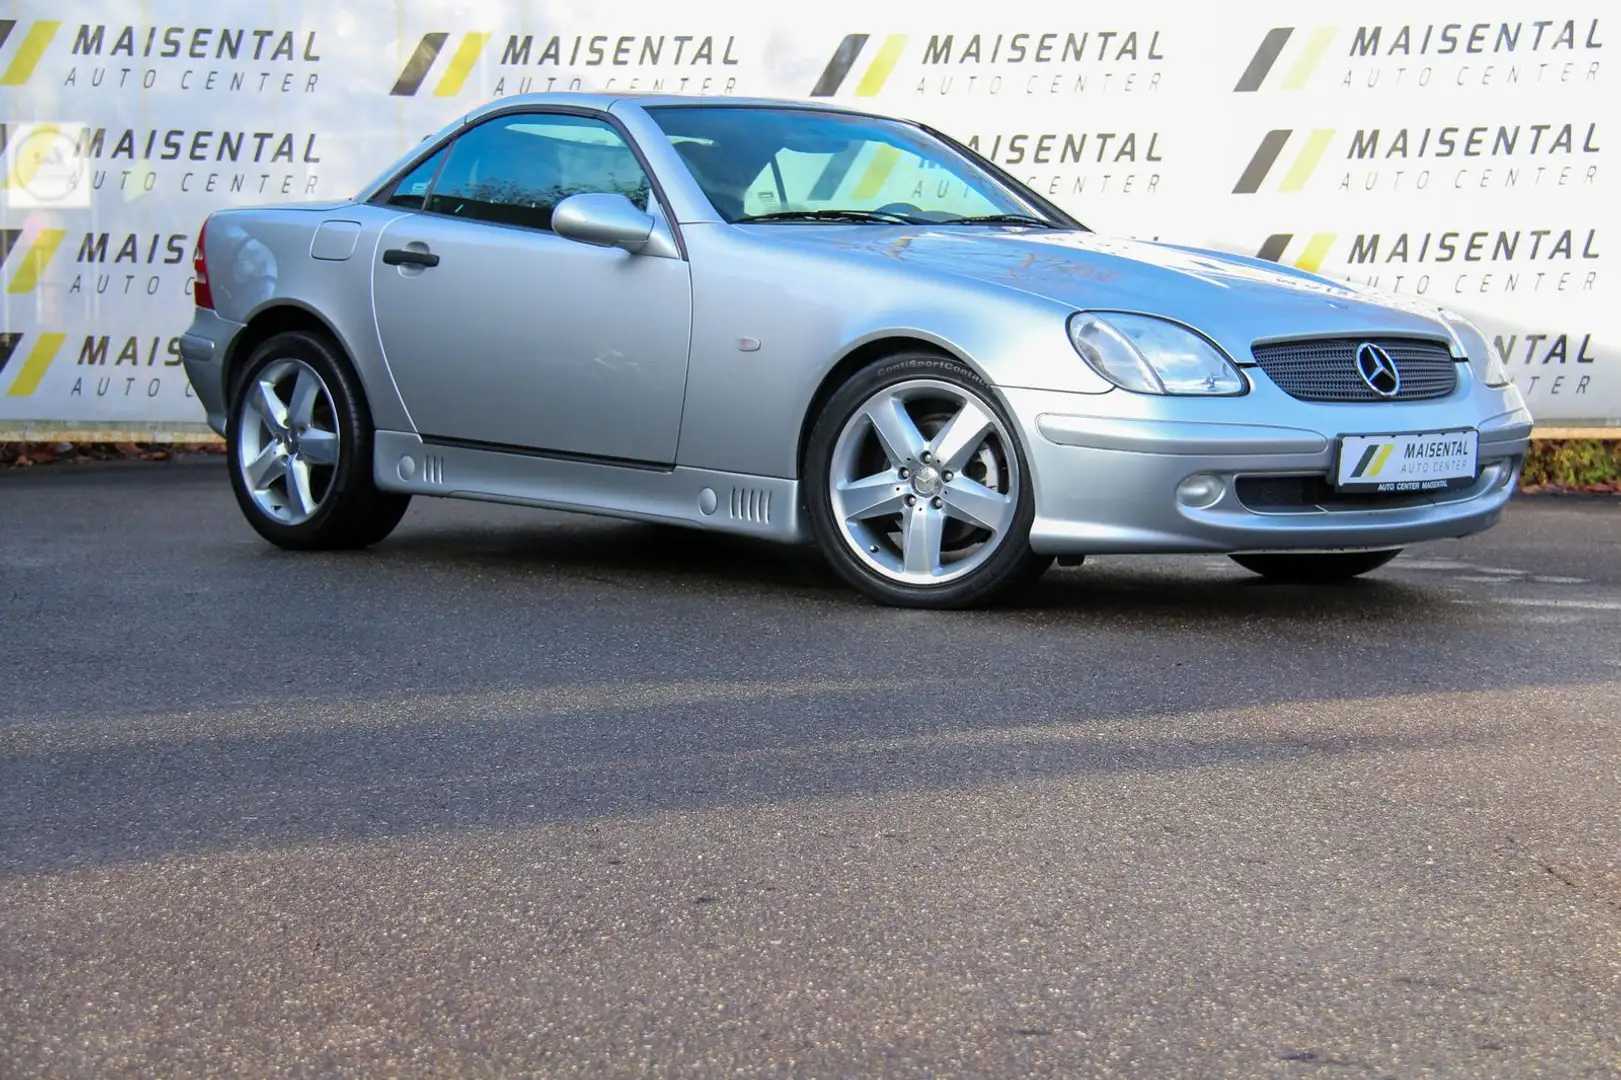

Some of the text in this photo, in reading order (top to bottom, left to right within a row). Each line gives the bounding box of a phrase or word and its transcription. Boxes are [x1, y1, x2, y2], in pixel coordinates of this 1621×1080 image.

[72, 24, 321, 62] MAISENTAL
[501, 35, 739, 66] MAISENTAL
[922, 31, 1164, 64] MAISENTAL
[1349, 19, 1603, 57] MAISENTAL
[64, 67, 319, 93] AUTO CENTER
[493, 77, 737, 96] AUTO CENTER
[916, 73, 1162, 96] AUTO CENTER
[1341, 61, 1600, 88] AUTO CENTER
[73, 128, 321, 163] MAISENTAL
[1347, 123, 1600, 160] MAISENTAL
[66, 170, 319, 194] AUTO CENTER
[1339, 166, 1598, 192] AUTO CENTER
[76, 232, 188, 264] MAIS
[1347, 229, 1600, 264] MAISENTAL
[70, 275, 160, 295] AUTO
[1454, 271, 1598, 294] CENTER
[77, 335, 183, 366] MAIS
[1492, 333, 1595, 365] NTAL
[71, 377, 161, 398] AUTO
[1404, 441, 1468, 458] MAISENTAL
[1401, 460, 1467, 474] AUTO CENTER
[1378, 481, 1447, 492] AUTO CENTER MAISENTAL
